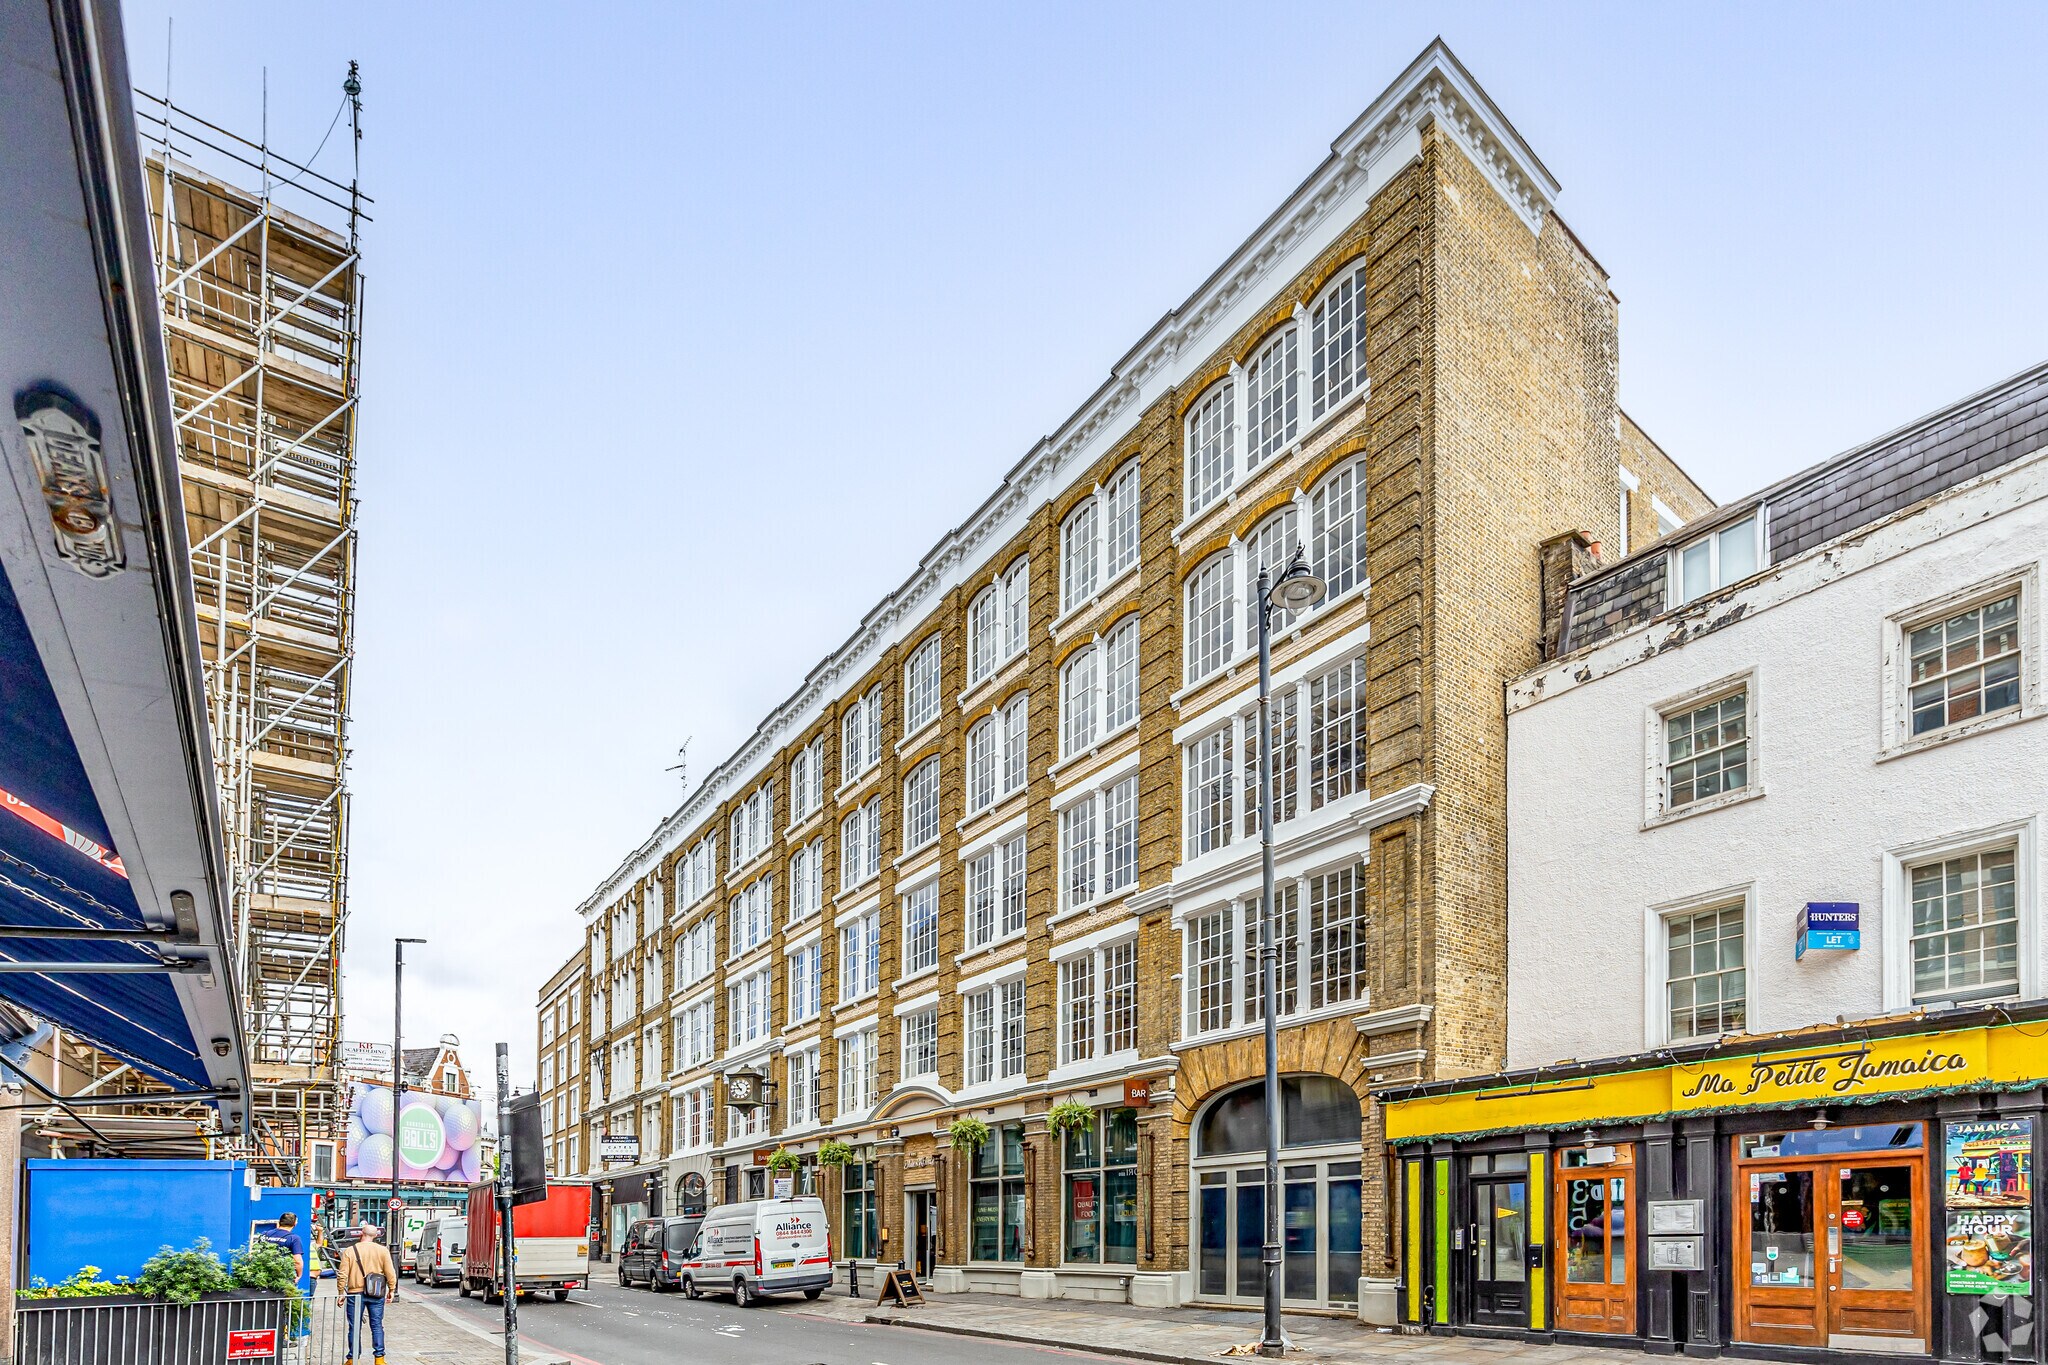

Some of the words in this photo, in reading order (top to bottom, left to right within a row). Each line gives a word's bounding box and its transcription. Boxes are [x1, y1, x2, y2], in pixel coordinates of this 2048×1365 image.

[1810, 912, 1857, 921] HUNTERS
[1826, 935, 1842, 944] LET
[359, 1042, 373, 1050] KB
[1682, 1073, 1736, 1097] Ma
[1740, 1060, 1827, 1095] Petite
[1833, 1049, 1967, 1092] Jamaica
[1131, 1088, 1147, 1098] BAR
[1957, 1122, 2021, 1133] JAMAICA
[1081, 1210, 1097, 1218] FOOD
[1957, 1214, 2018, 1225] HAPPY
[776, 1222, 812, 1231] Alliance
[1961, 1224, 2014, 1235] HOUR
[707, 1235, 723, 1245] Alliance
